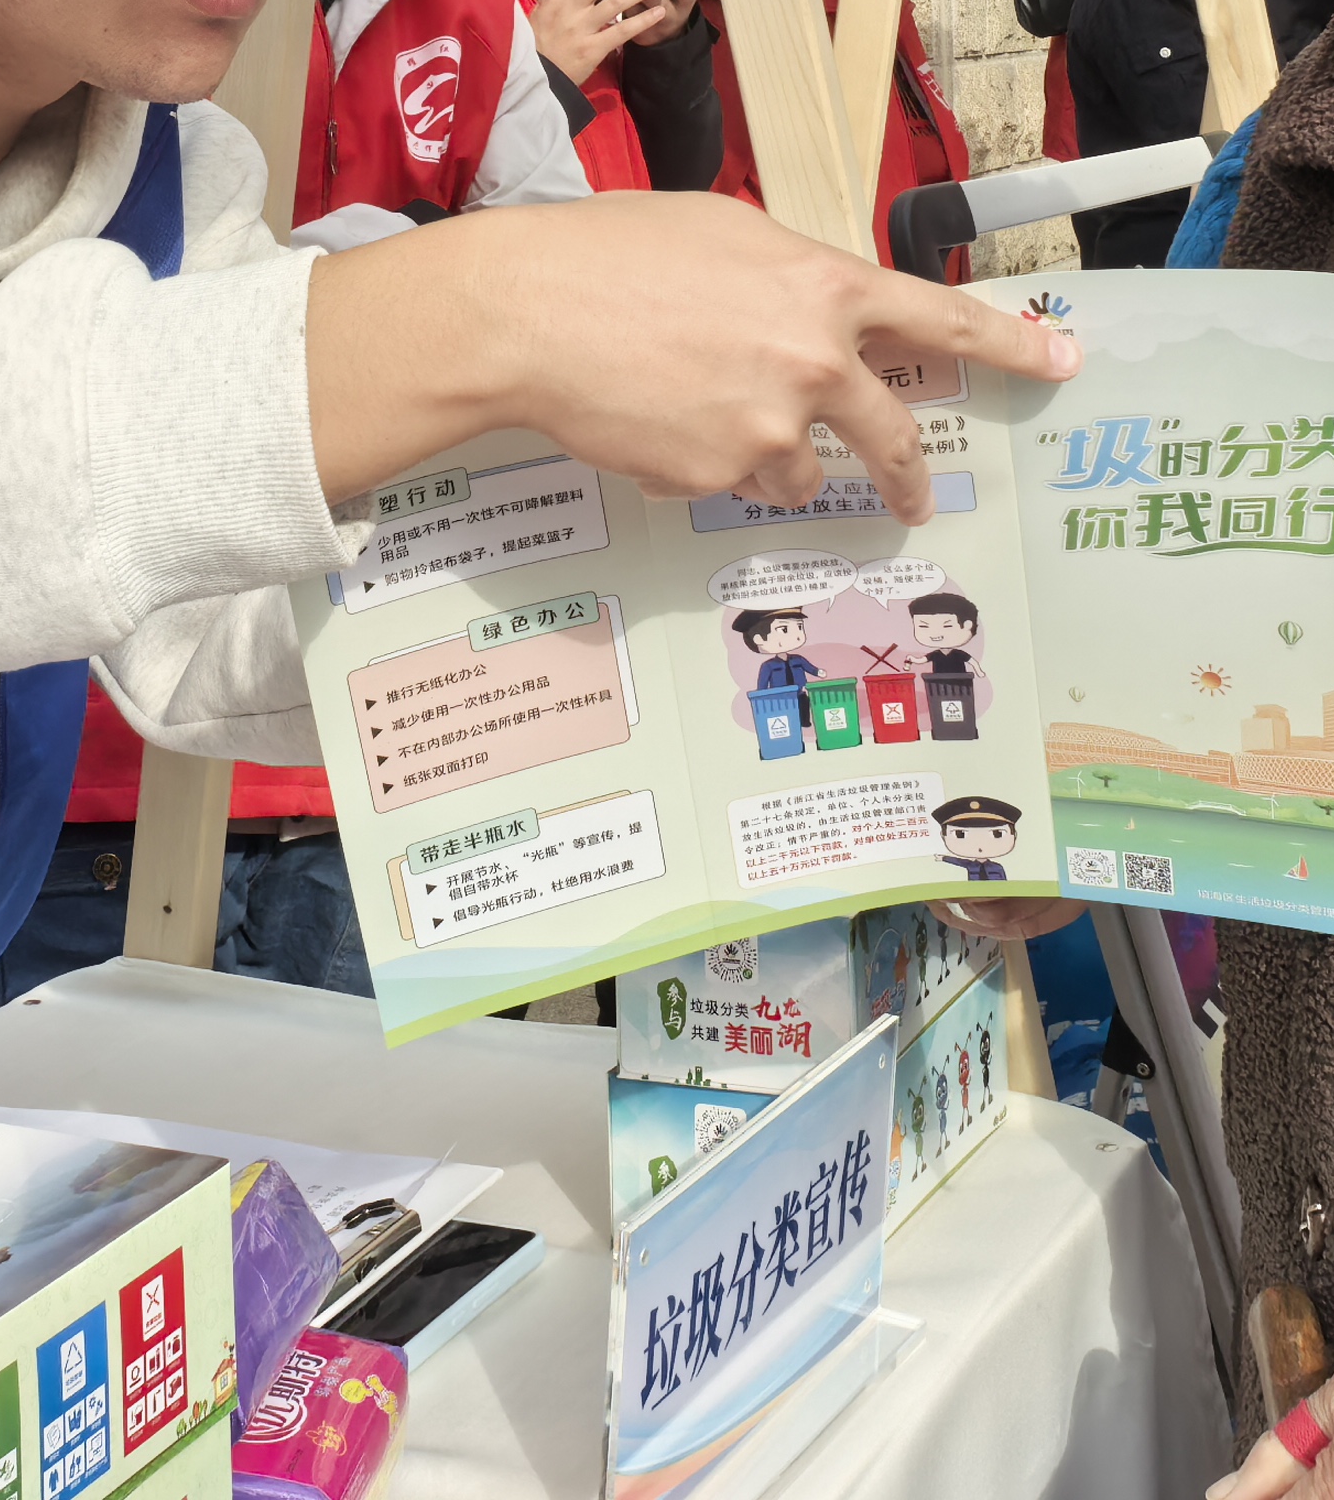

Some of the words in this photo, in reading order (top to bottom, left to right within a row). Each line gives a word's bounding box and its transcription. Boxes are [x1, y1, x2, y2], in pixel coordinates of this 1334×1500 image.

[378, 488, 584, 550] 少用或不用一次性不可降解塑料
[380, 545, 410, 565] 用品
[482, 602, 585, 641] 绿色办公
[386, 663, 487, 704] 推行无纸化办公
[391, 675, 551, 732] 减少使用一次性办公用品
[398, 689, 613, 759] 不在内部办公场所使用一次性杯具
[403, 751, 489, 788] 纸张双面打印
[420, 820, 527, 864] 带走半瓶水
[449, 870, 519, 901] 倡自带水杯
[640, 1129, 871, 1411] 垃圾分类宣传
